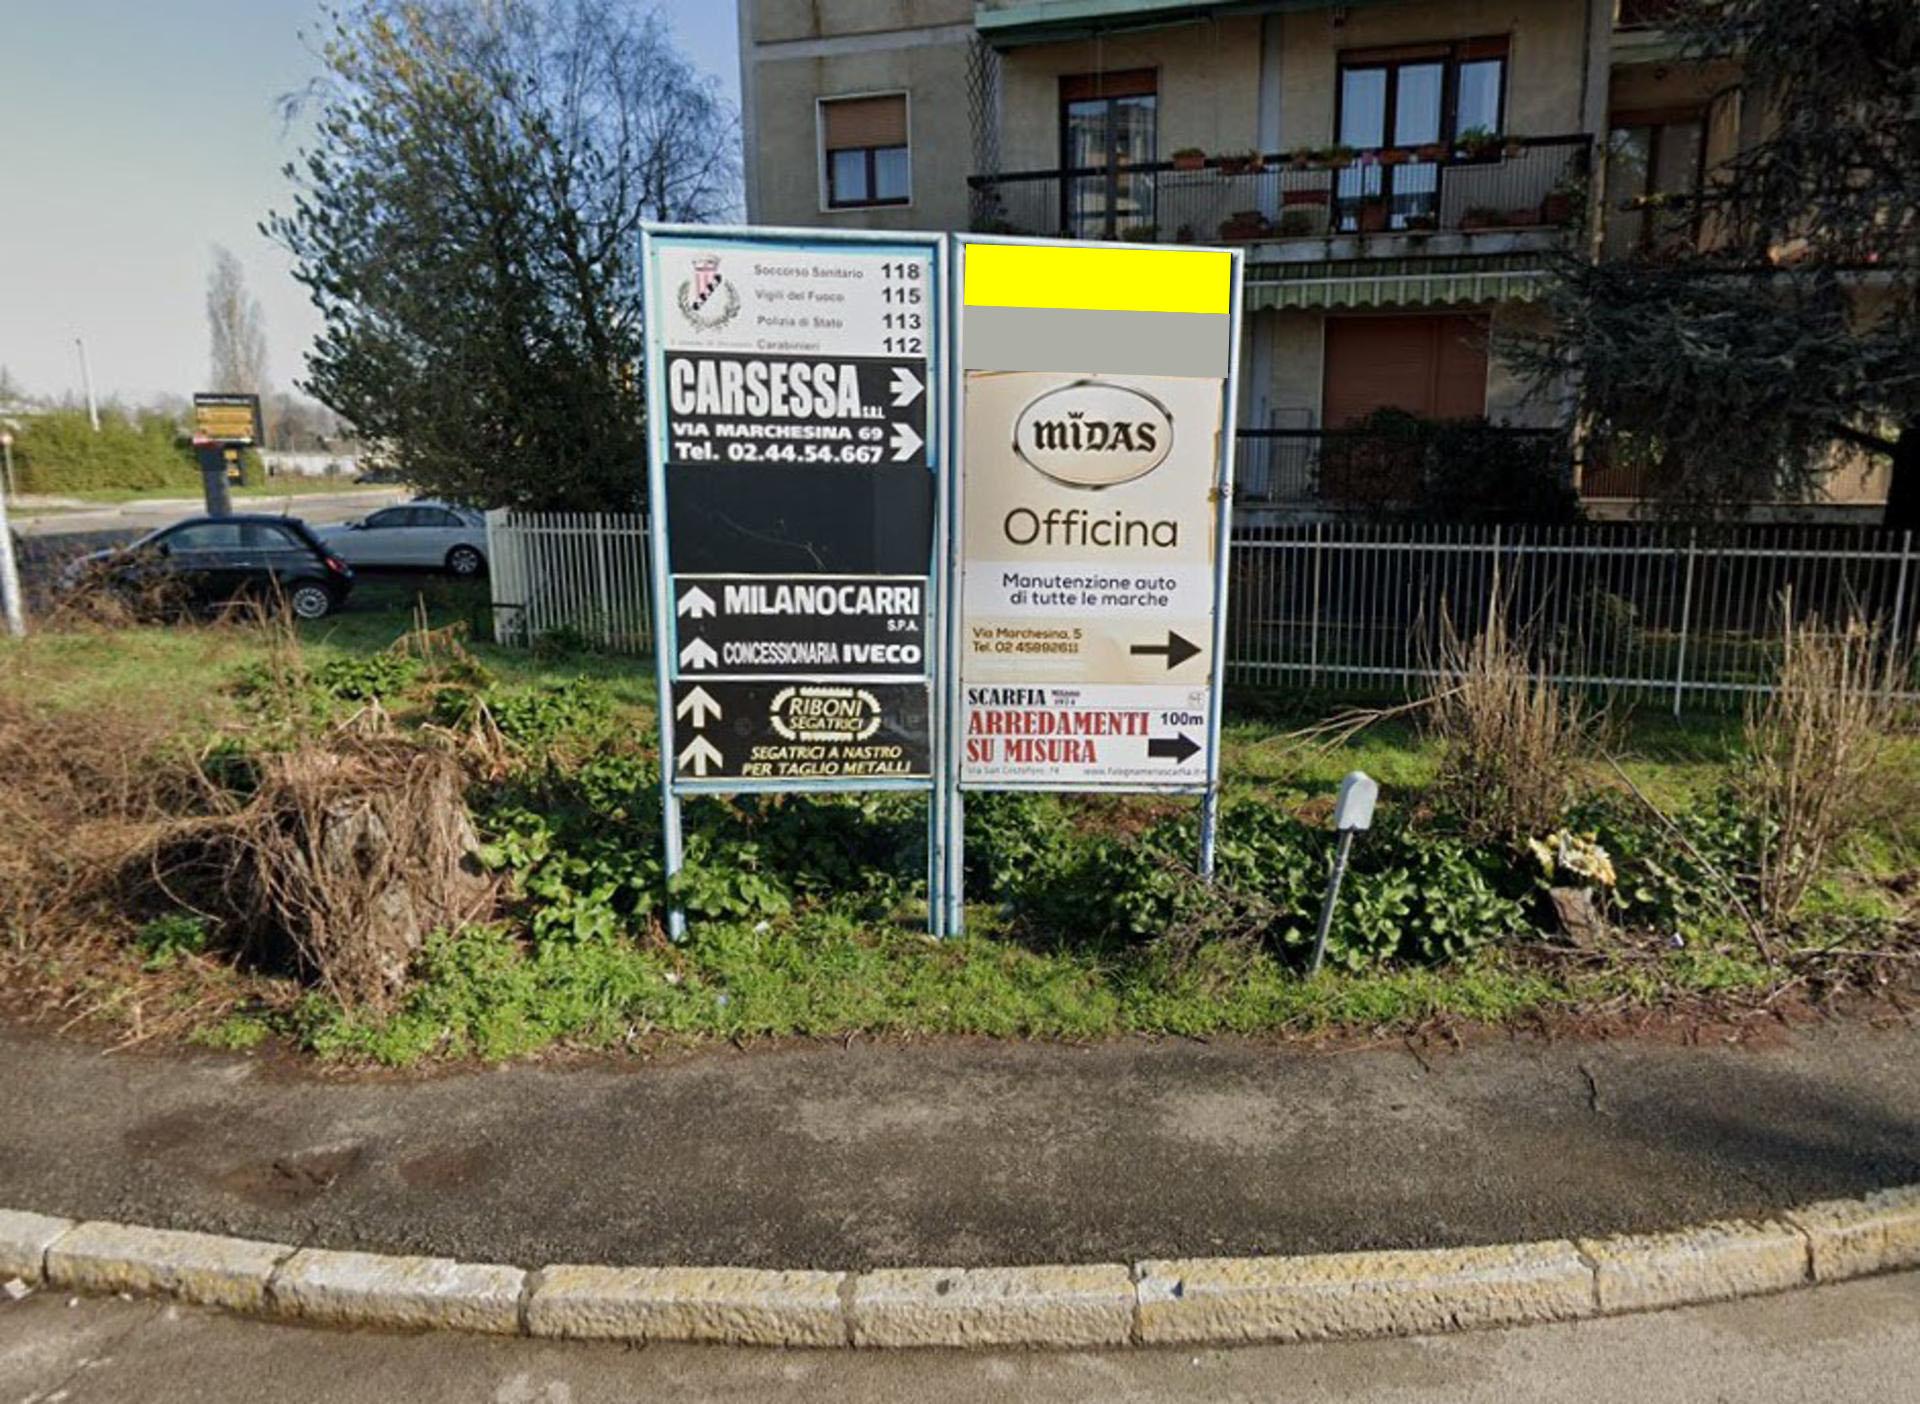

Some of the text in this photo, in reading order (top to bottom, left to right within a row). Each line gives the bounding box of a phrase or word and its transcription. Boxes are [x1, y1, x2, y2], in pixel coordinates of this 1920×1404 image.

[753, 264, 864, 279] Soccorso Sanitario
[881, 262, 920, 280] 118
[754, 289, 845, 302] Vigili del Fuoco
[881, 286, 921, 305] 115
[757, 315, 843, 328] Polizia di Stato
[882, 313, 922, 330] 113
[756, 338, 820, 350] Carabinieri
[882, 337, 922, 354] 112
[669, 358, 862, 419] CARSESSA
[672, 422, 884, 441] VIA MARCHESINA 69
[675, 442, 884, 464] Tel. 02.44.54.667
[1004, 507, 1178, 548] Officina
[1002, 573, 1176, 590] Manutenzione auto
[724, 585, 920, 615] MILANOCARRI
[1010, 592, 1169, 606] di tutte le marche
[972, 627, 993, 638] Via
[1073, 628, 1083, 639] 5
[723, 641, 921, 664] CONCESSIONARIA IVECO
[995, 641, 1013, 653] 02
[968, 687, 1046, 705] SCARFIA
[789, 698, 863, 717] RIBONI
[788, 716, 864, 731] SEGATRICI
[968, 710, 1204, 736] ARREDAMENTI 100m
[750, 746, 902, 761] SEGATRICI A NASTRO
[966, 738, 1097, 763] SU MISURA
[742, 761, 911, 777] PER TAGLIO METALLI
